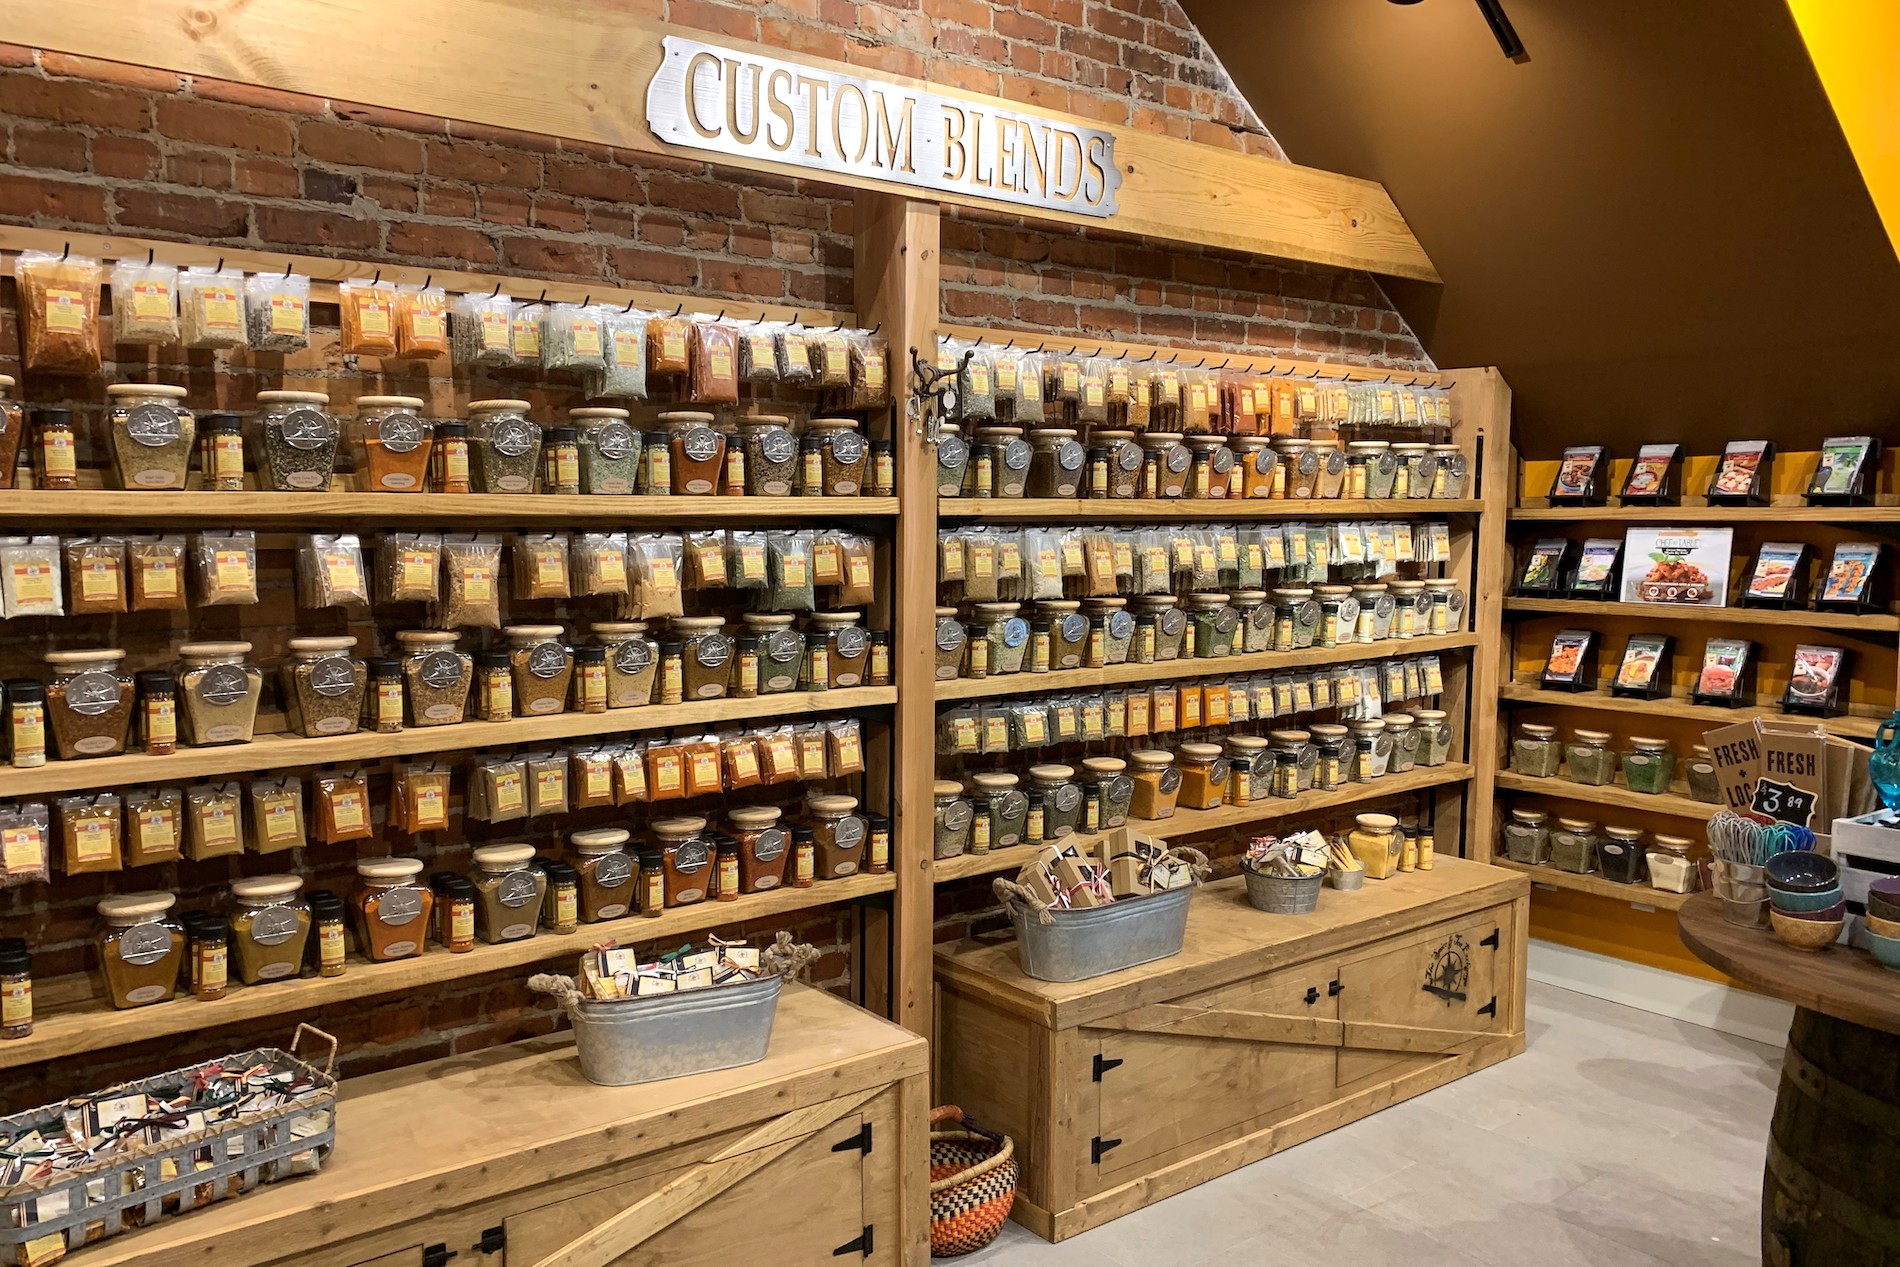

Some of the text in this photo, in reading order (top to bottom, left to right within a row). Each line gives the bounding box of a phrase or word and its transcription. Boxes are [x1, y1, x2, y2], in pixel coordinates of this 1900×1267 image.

[685, 51, 1107, 207] CUSTOM BLENDS
[1713, 738, 1760, 768] FRESH
[1767, 750, 1816, 776] FRESH
[1726, 781, 1758, 808] LOC
